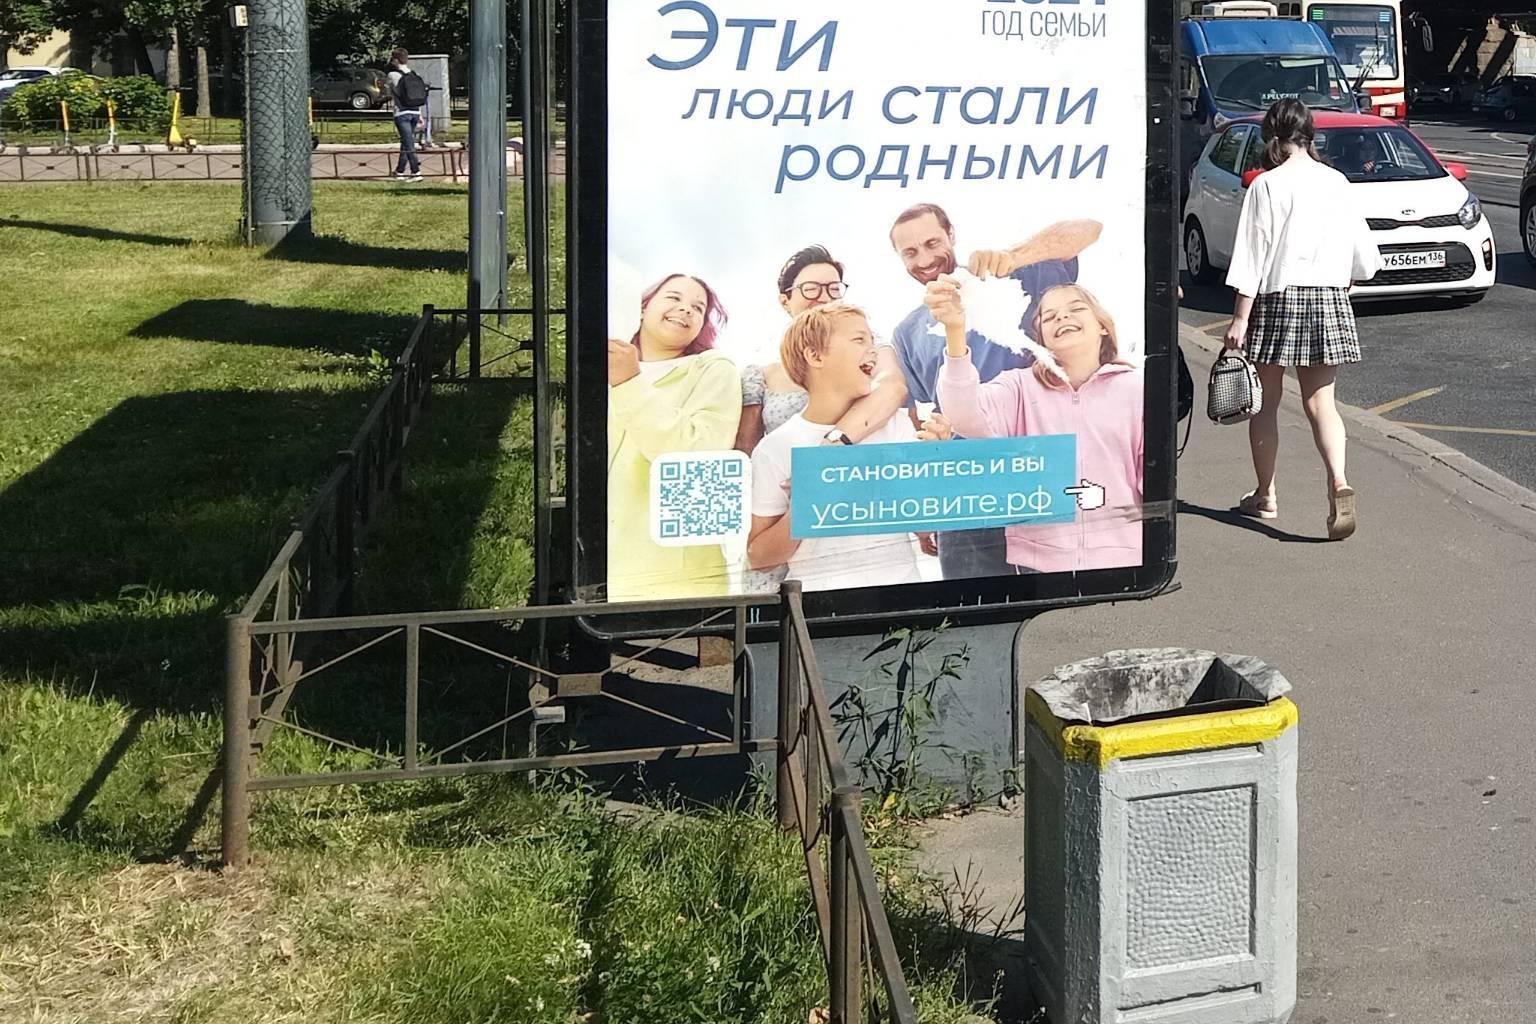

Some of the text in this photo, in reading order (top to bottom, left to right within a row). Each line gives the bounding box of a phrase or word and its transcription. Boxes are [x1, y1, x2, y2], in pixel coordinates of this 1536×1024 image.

[646, 0, 839, 72] Эти
[681, 85, 1098, 127] люди стали
[774, 144, 1109, 194] родными
[1384, 254, 1427, 266] У656ЕМ
[1428, 252, 1443, 261] 136
[821, 456, 1044, 483] СТАНОВИТЕСЬ И ВЫ
[811, 485, 1052, 525] усыновите.рф
